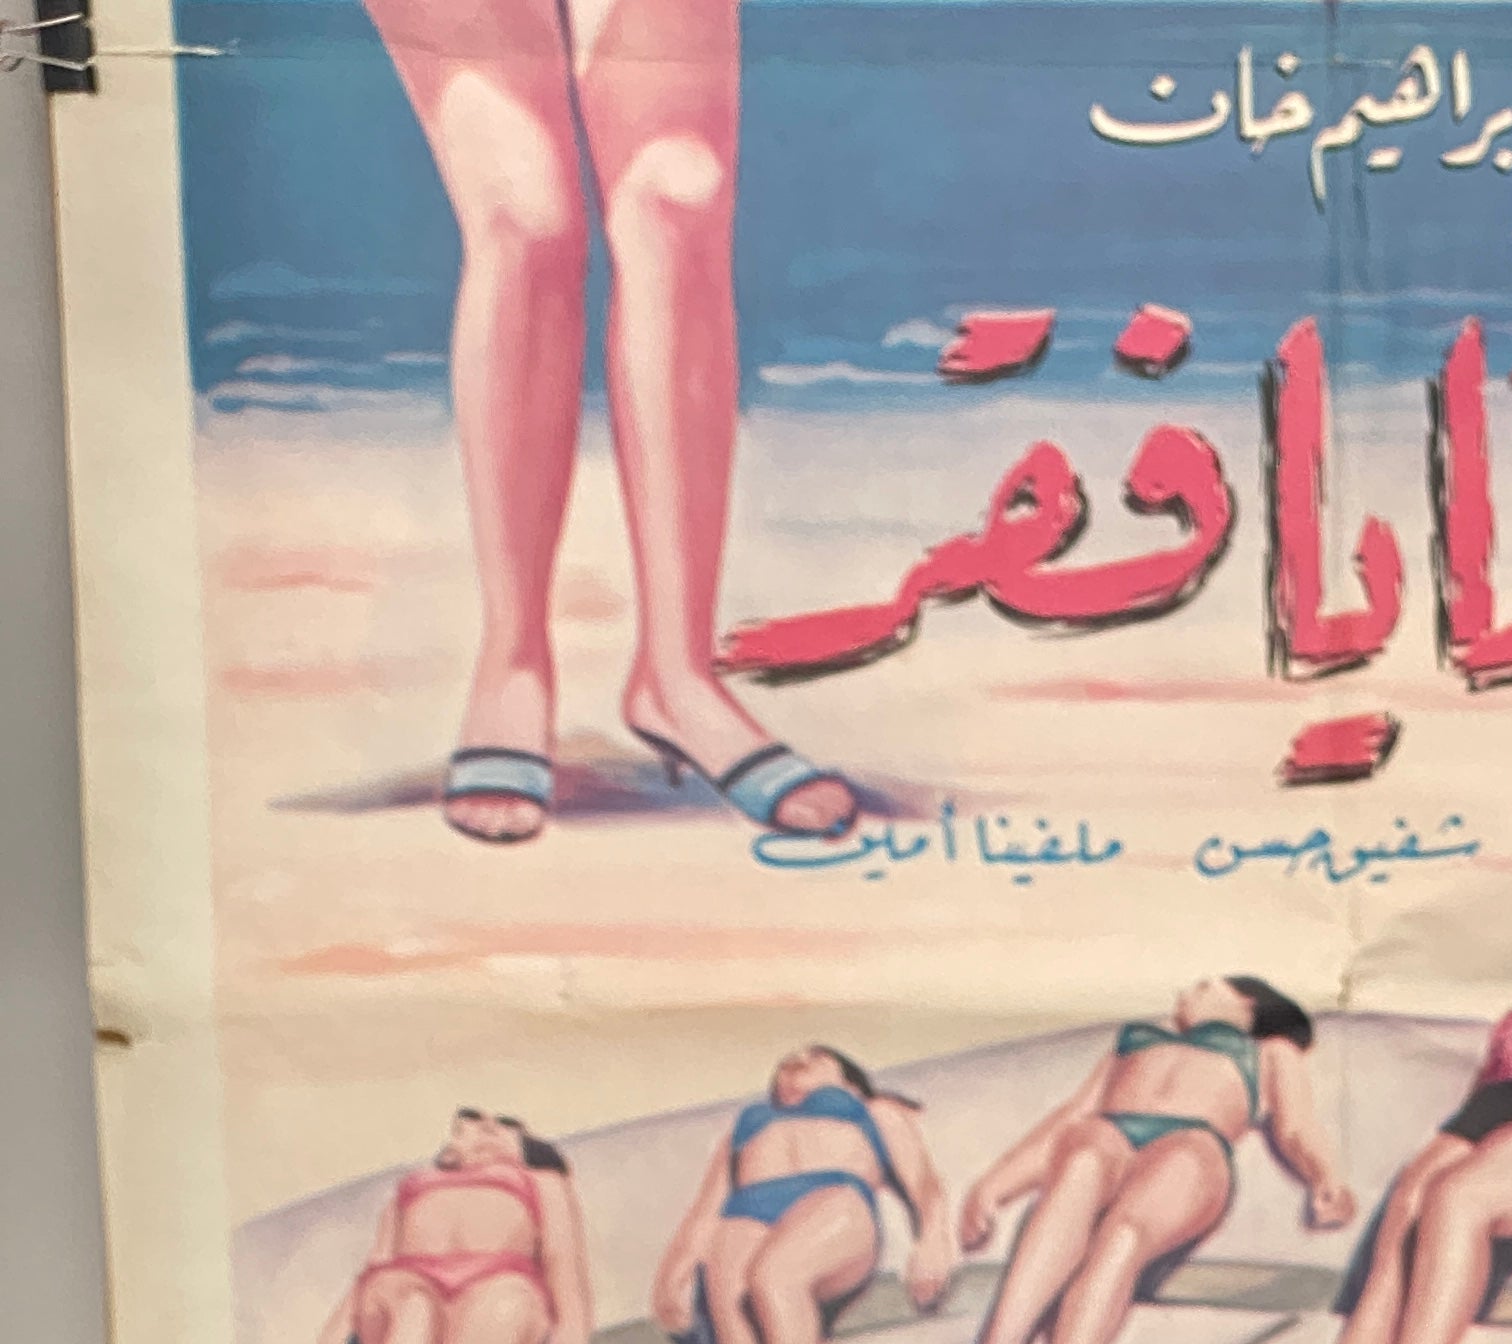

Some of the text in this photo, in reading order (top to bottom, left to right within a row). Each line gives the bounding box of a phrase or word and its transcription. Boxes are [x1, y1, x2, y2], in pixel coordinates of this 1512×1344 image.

[1088, 44, 1316, 157] خان
[712, 304, 1238, 686] فقر
[1262, 315, 1403, 785] يا
